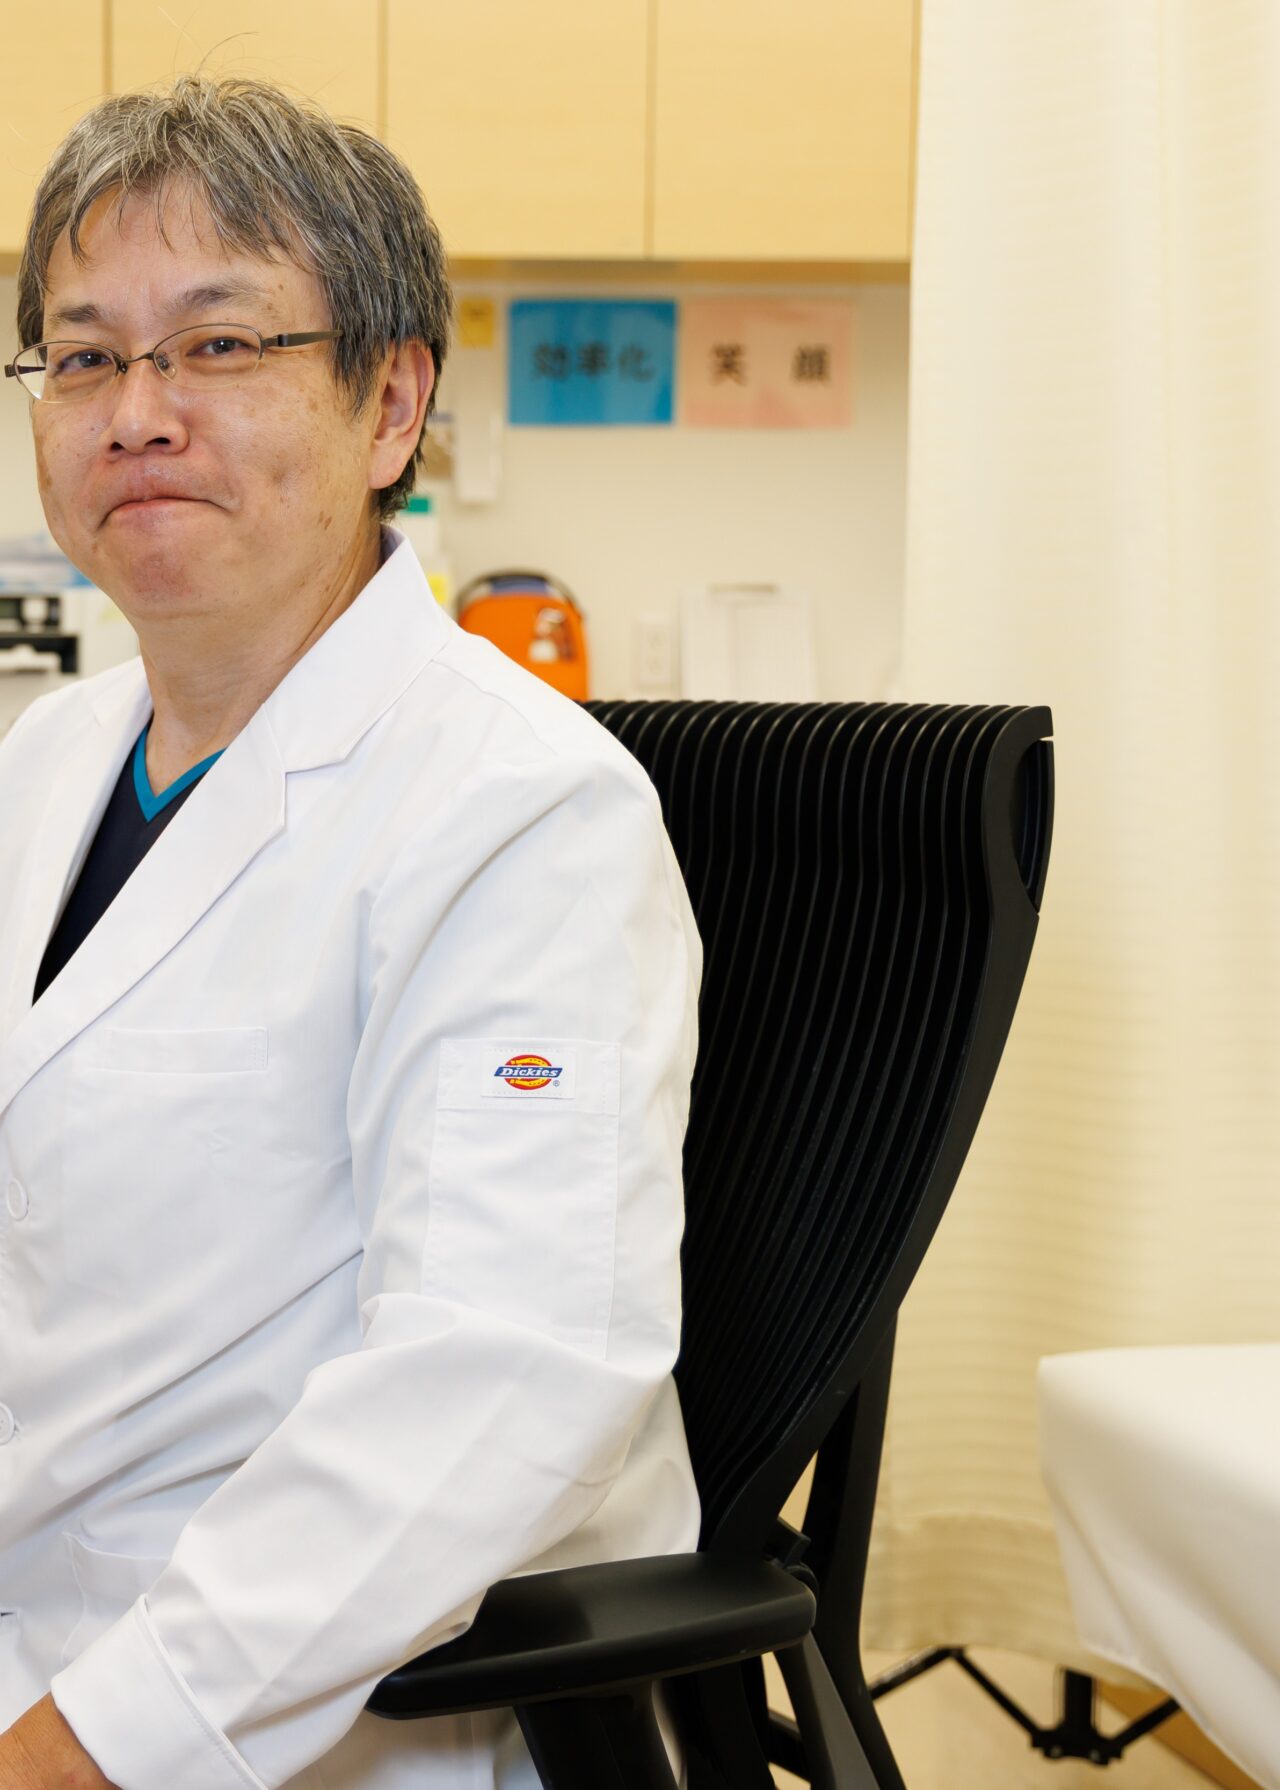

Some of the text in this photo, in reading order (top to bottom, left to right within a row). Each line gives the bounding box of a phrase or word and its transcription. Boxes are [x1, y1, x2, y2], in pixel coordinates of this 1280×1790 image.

[531, 341, 657, 383] 効率化
[501, 1067, 559, 1077] Dickies
